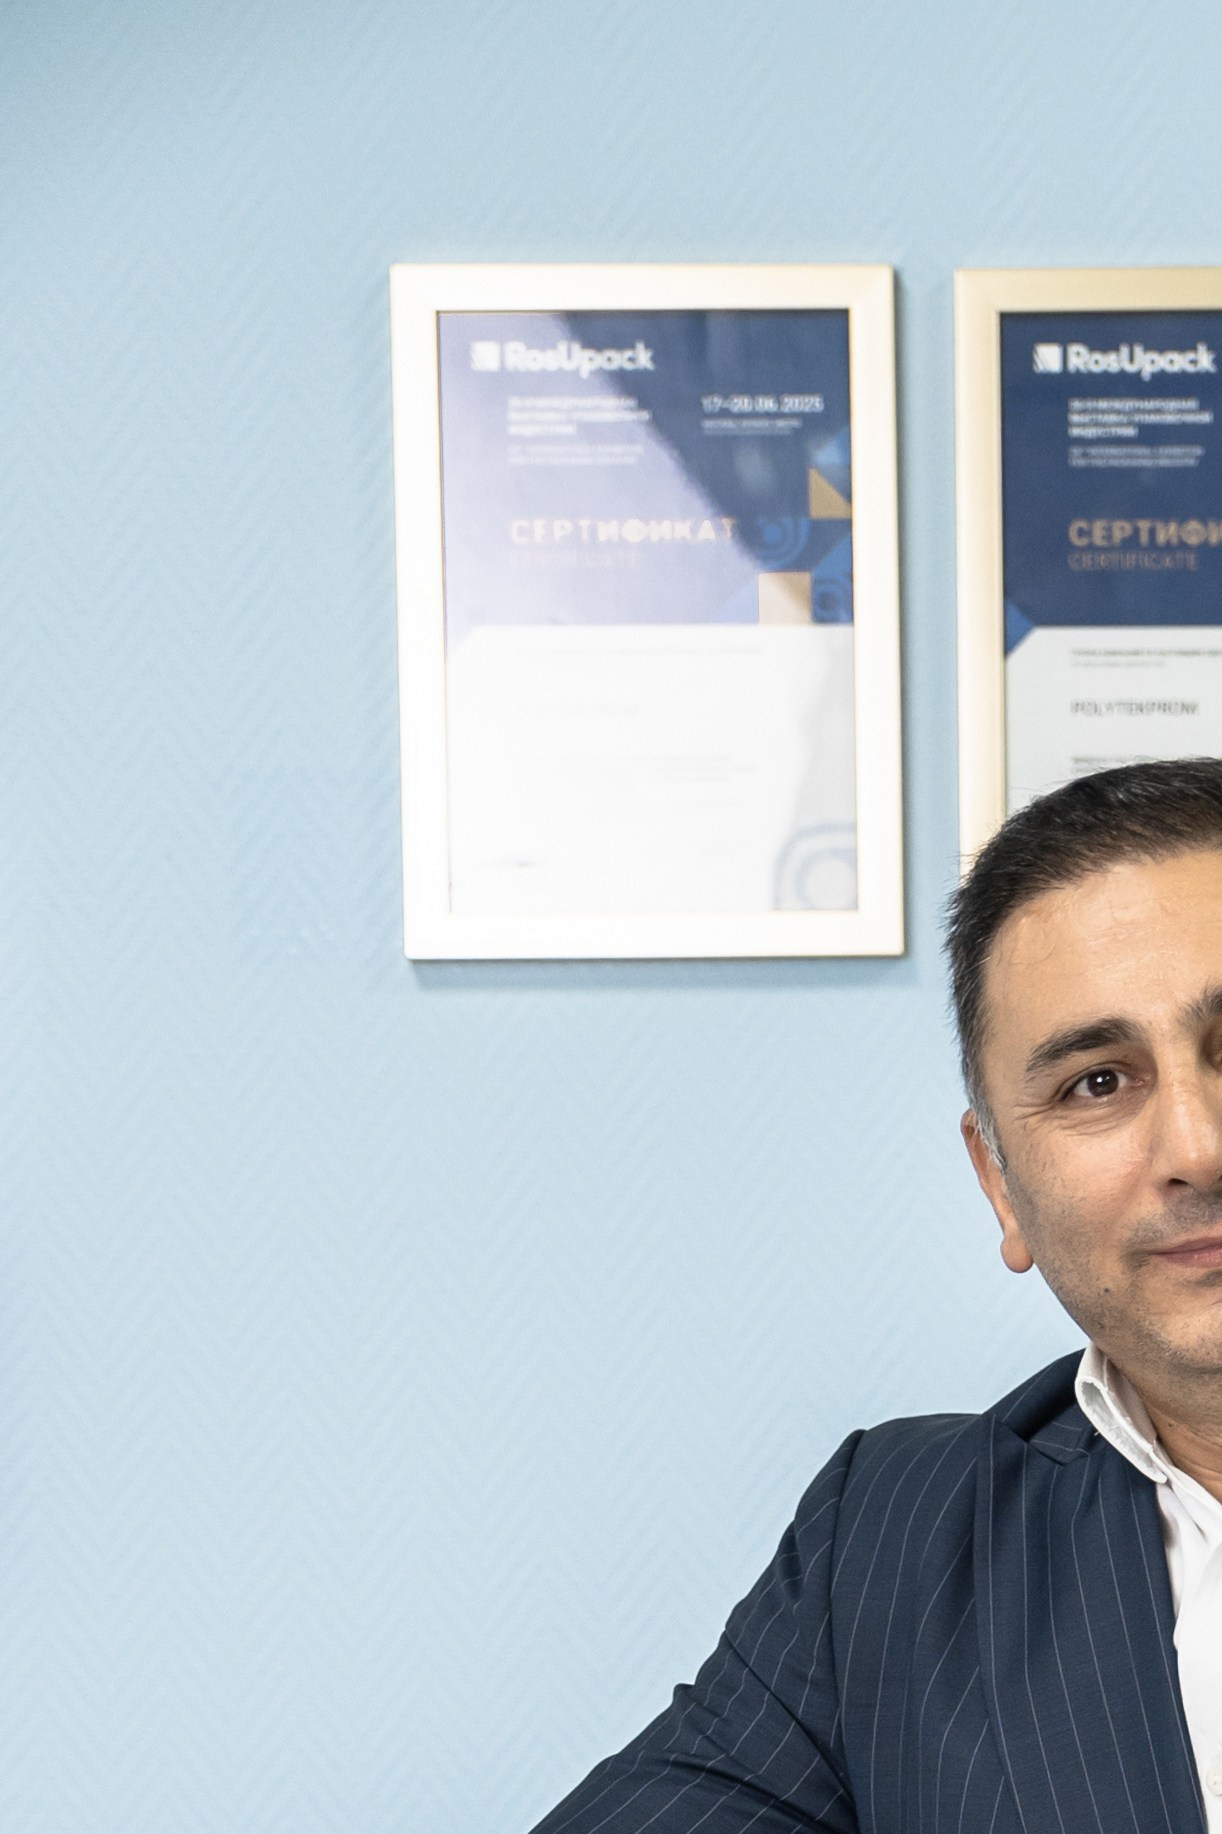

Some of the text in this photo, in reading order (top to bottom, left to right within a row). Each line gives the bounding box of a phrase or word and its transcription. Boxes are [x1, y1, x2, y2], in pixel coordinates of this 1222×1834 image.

[502, 340, 654, 379] RosUpack
[1066, 342, 1217, 381] RosUpack
[509, 516, 737, 545] СЕРТИФИКАТ
[1067, 551, 1200, 571] CERTIFICATE
